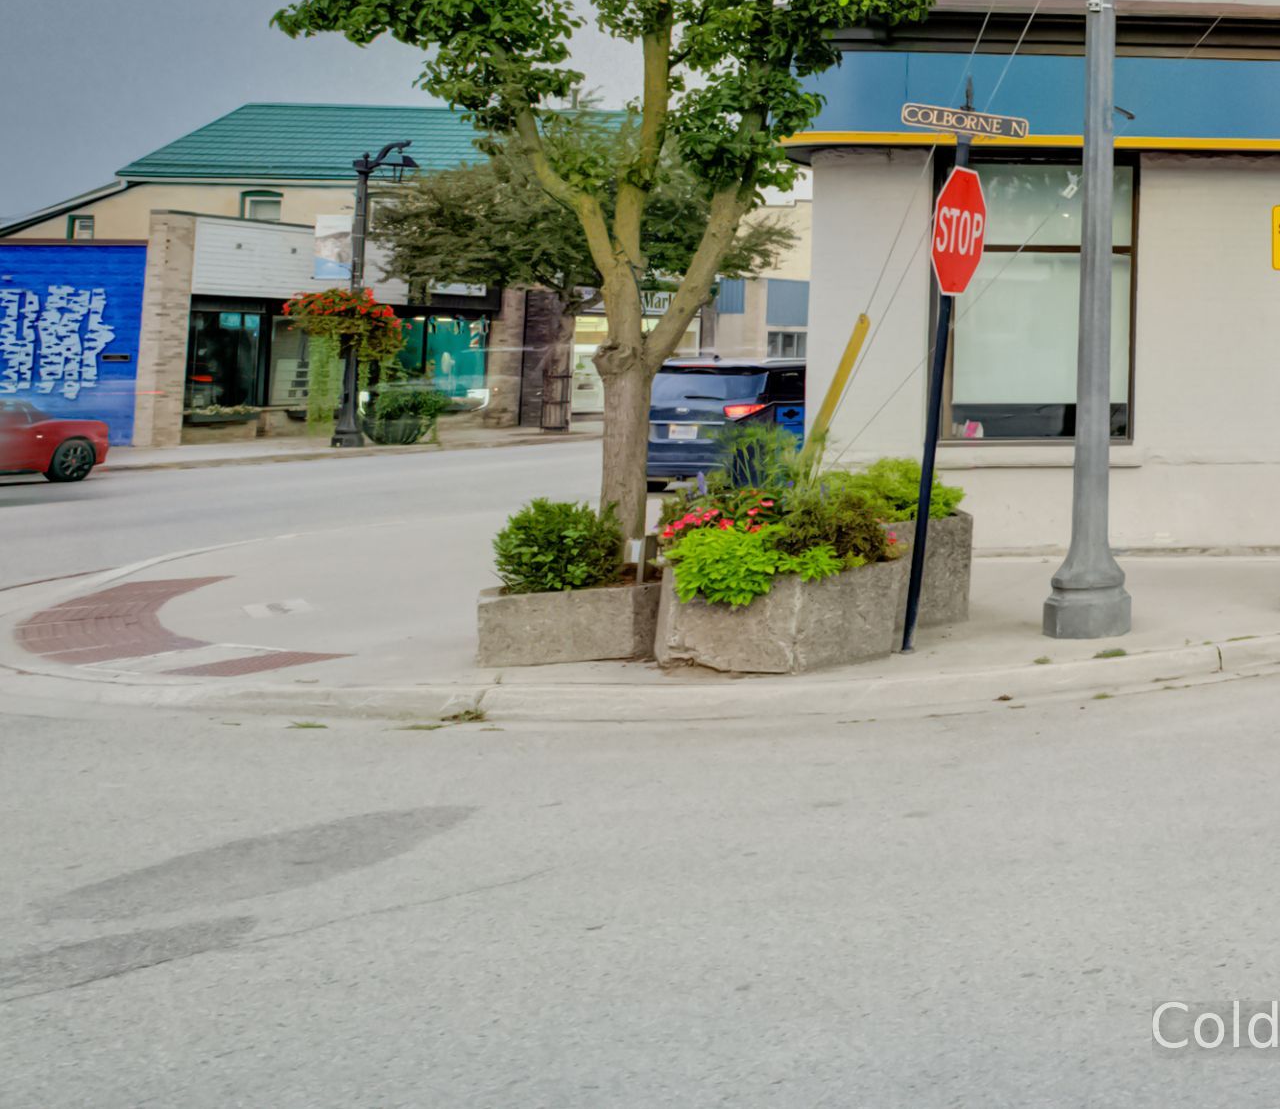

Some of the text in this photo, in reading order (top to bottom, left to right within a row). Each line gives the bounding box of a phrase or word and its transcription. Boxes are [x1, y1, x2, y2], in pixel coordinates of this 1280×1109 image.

[904, 107, 1026, 137] COLBORNE N
[936, 206, 983, 256] STOP
